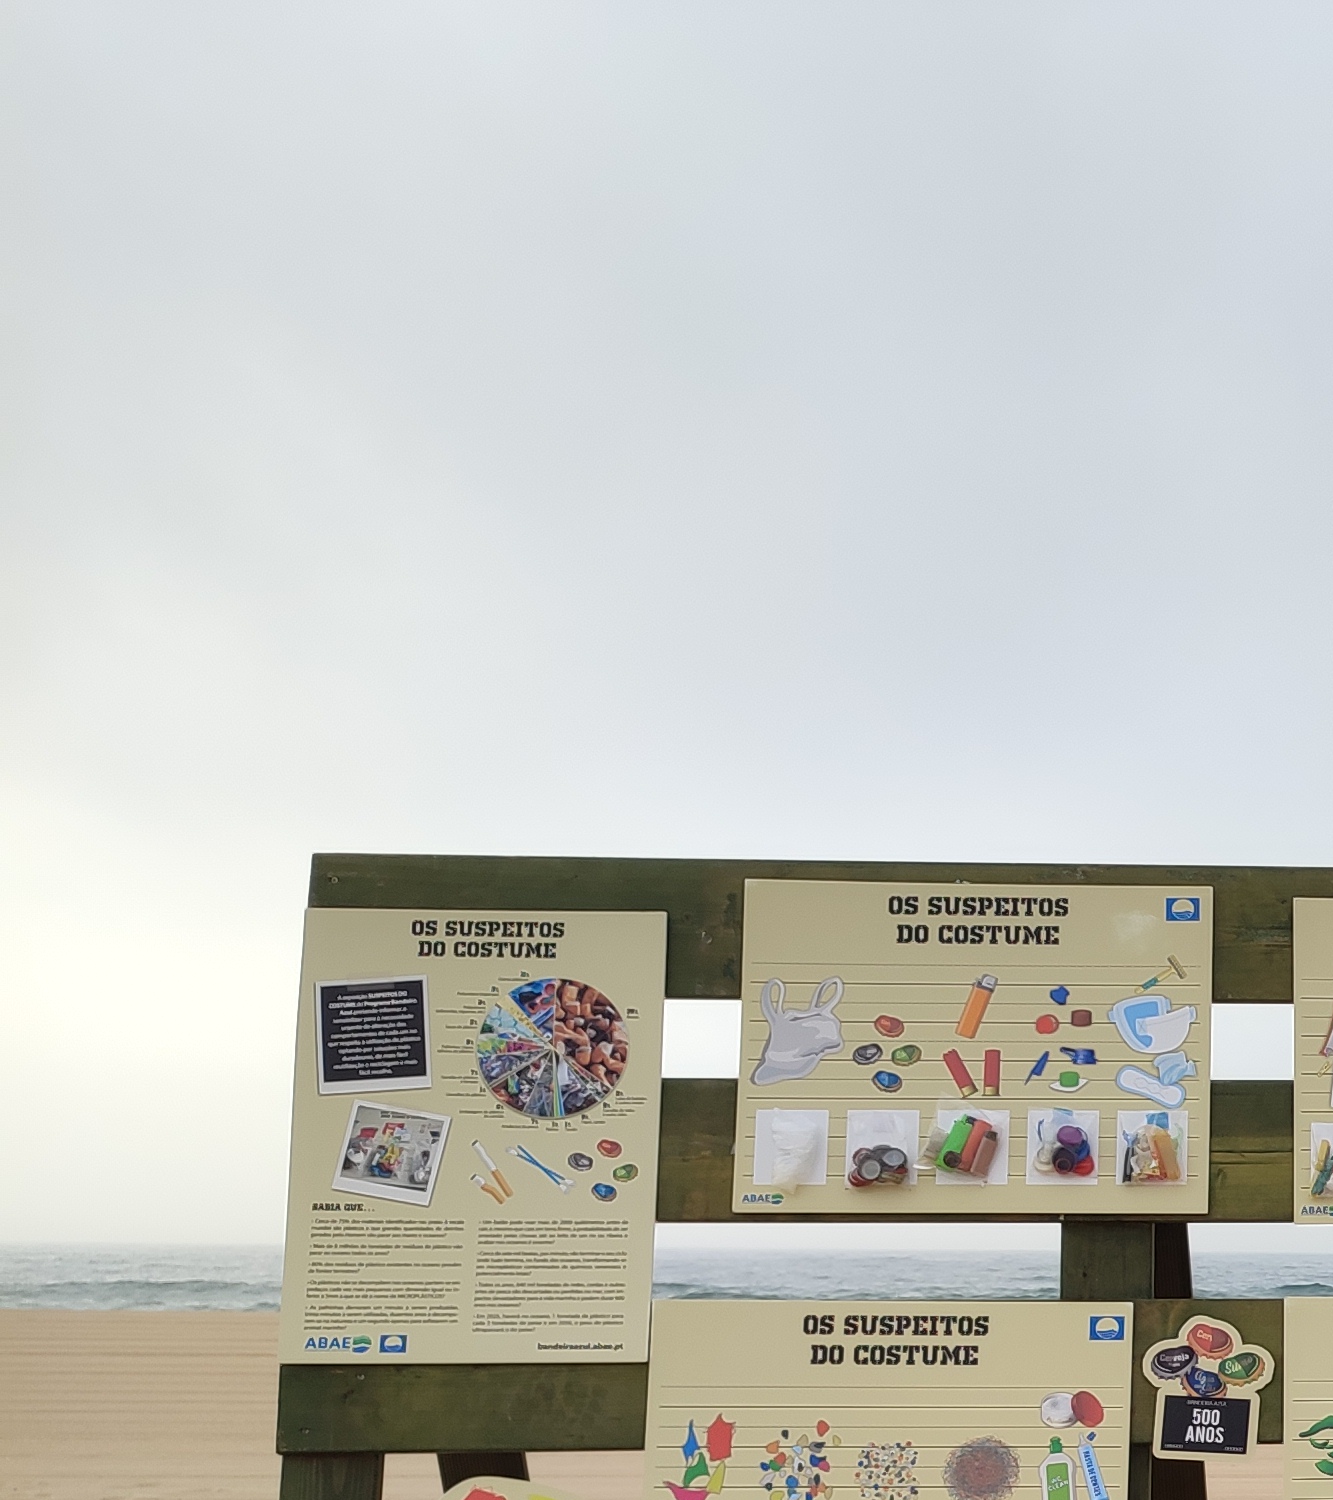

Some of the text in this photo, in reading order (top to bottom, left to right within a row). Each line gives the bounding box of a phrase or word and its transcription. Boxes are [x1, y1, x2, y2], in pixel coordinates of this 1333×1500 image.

[888, 896, 1069, 918] OS SUSPEITOS
[411, 920, 566, 938] OS SUSPEITOS
[896, 925, 1060, 945] DO COSTUME
[418, 941, 557, 959] DO COSTUME
[312, 1203, 341, 1211] SABIA
[742, 1193, 771, 1204] ABAE
[1301, 1206, 1329, 1216] ABAE
[803, 1315, 989, 1336] OS SUSPEITOS
[305, 1337, 352, 1349] ABAE
[810, 1345, 979, 1366] DO COSTUME
[1192, 1408, 1220, 1425] 500
[1185, 1425, 1225, 1443] ANOS
